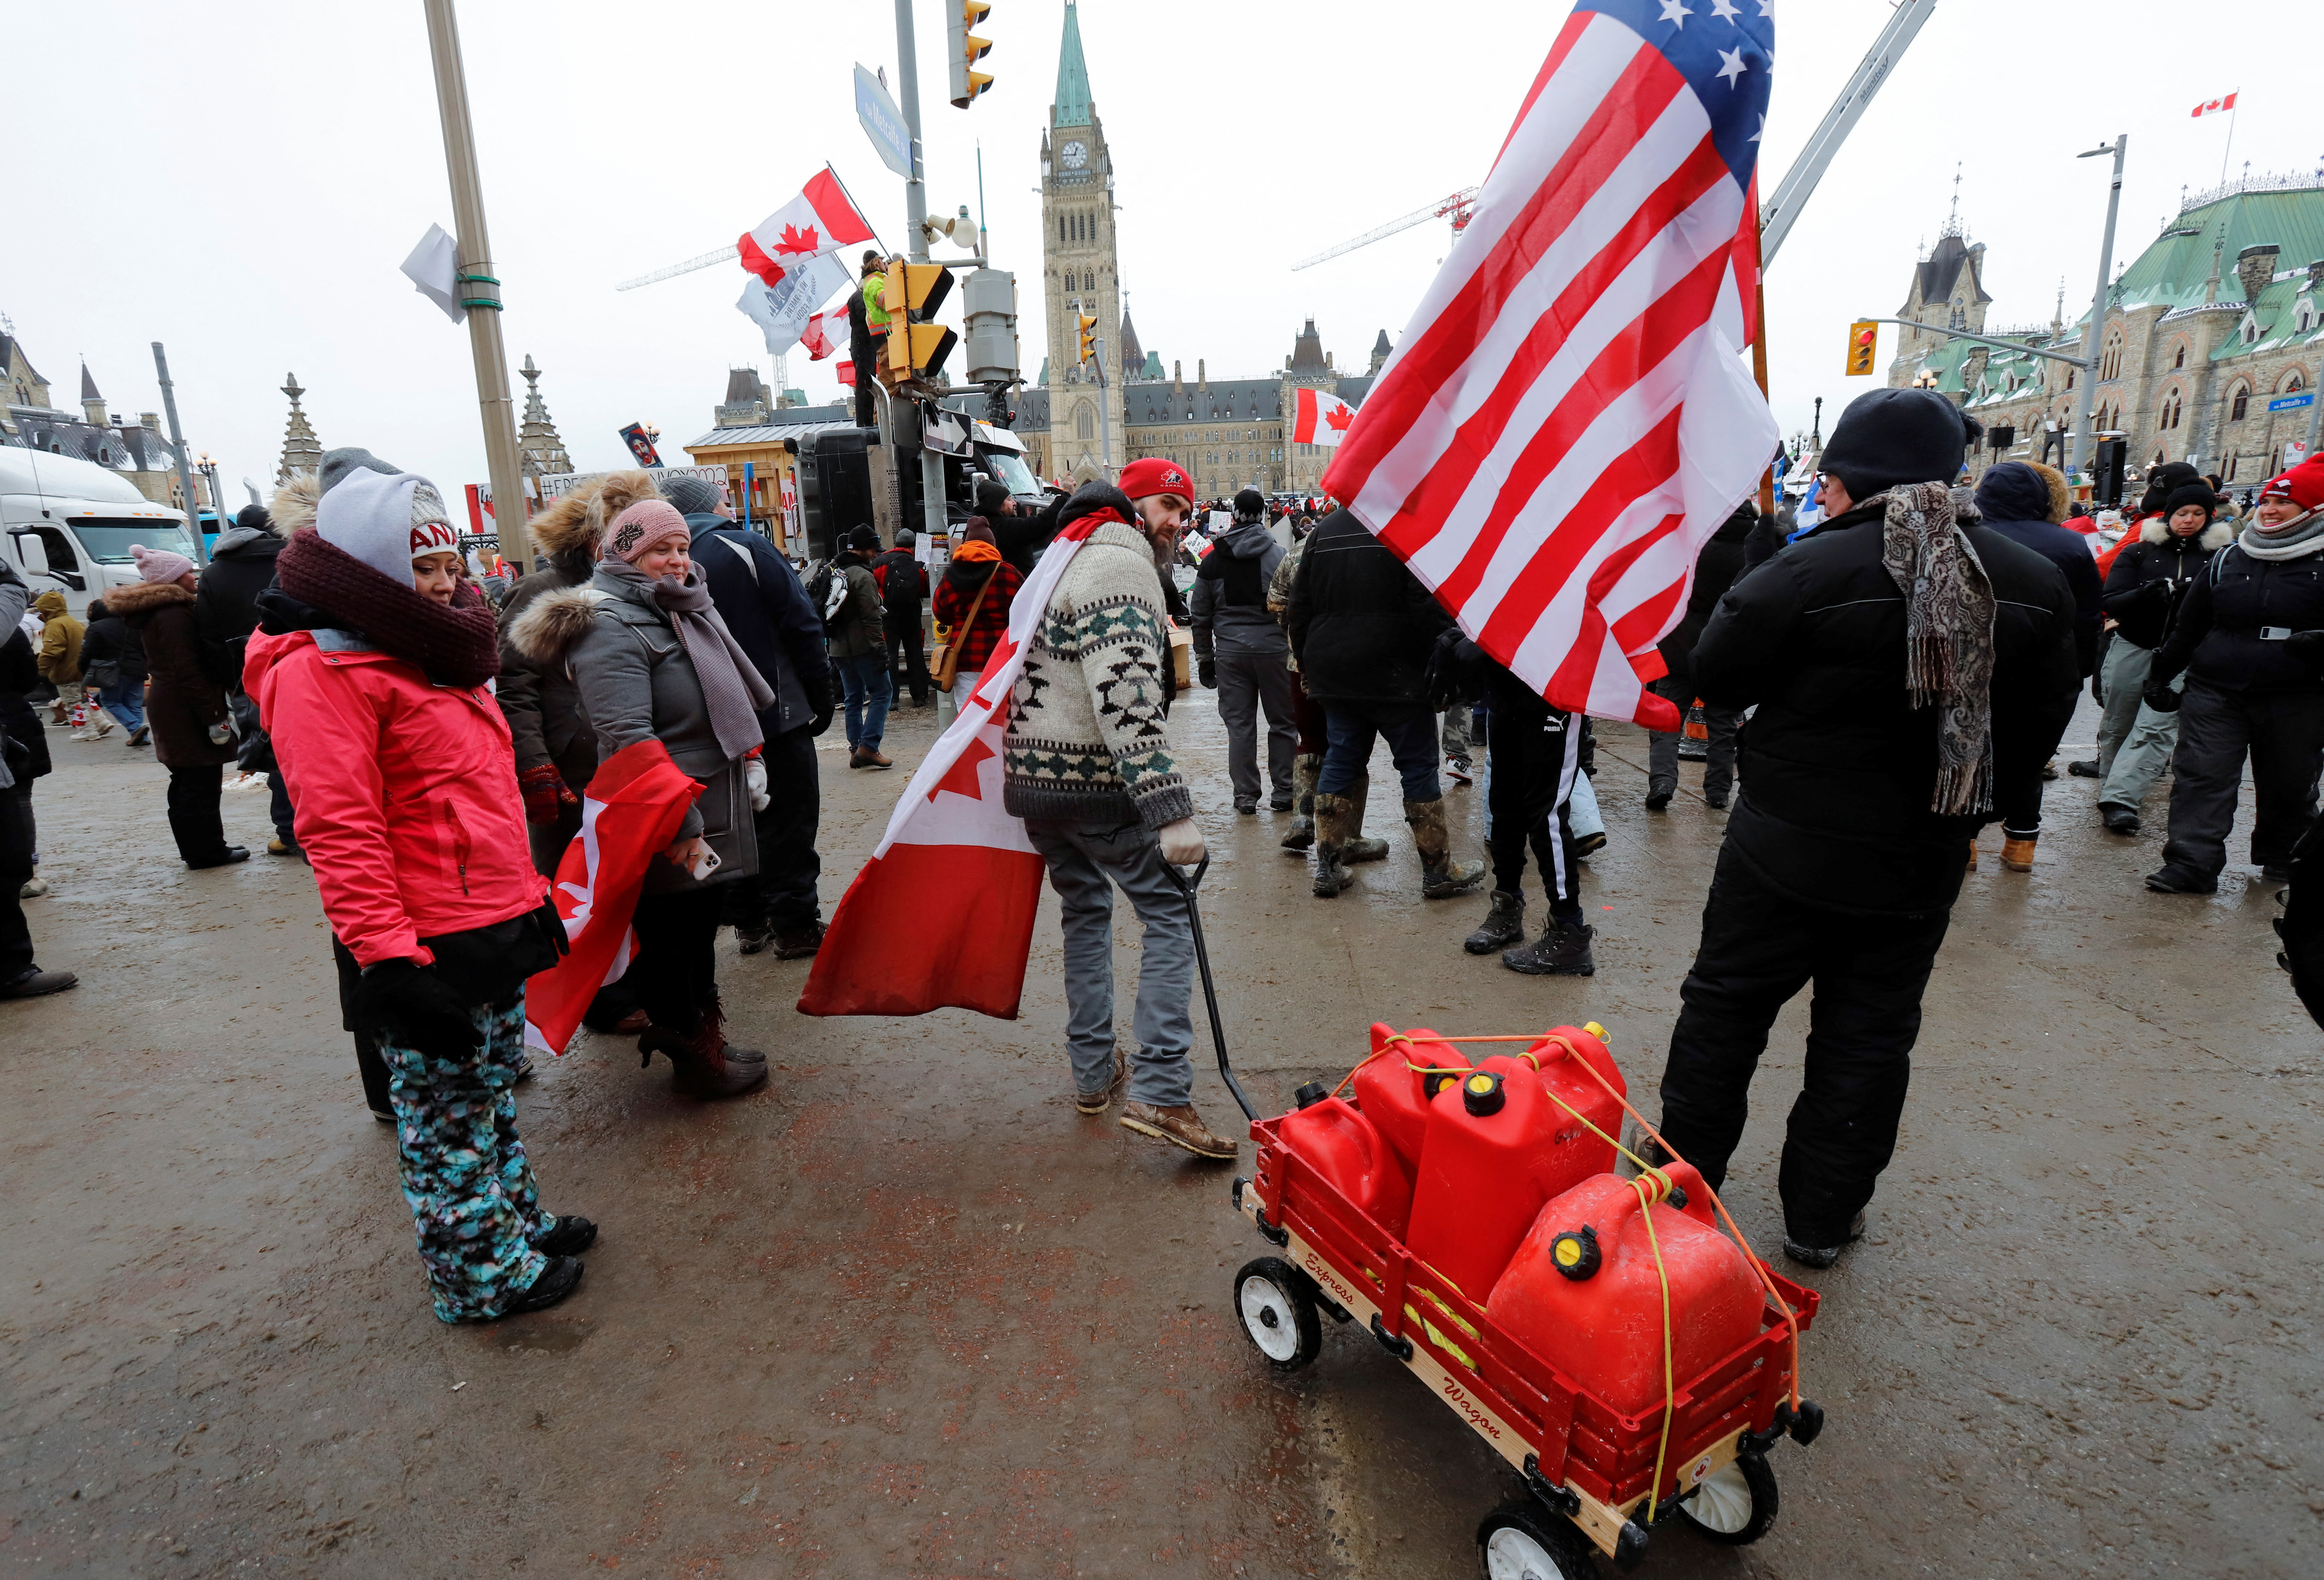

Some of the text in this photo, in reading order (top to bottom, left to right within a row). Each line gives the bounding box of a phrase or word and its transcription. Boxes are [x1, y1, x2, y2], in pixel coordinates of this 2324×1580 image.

[873, 101, 899, 151] Metcalfe
[2280, 398, 2301, 408] Metcalfe
[619, 426, 635, 434] CANADA
[1305, 1253, 1354, 1304] Express
[1444, 1376, 1500, 1439] Wagon
